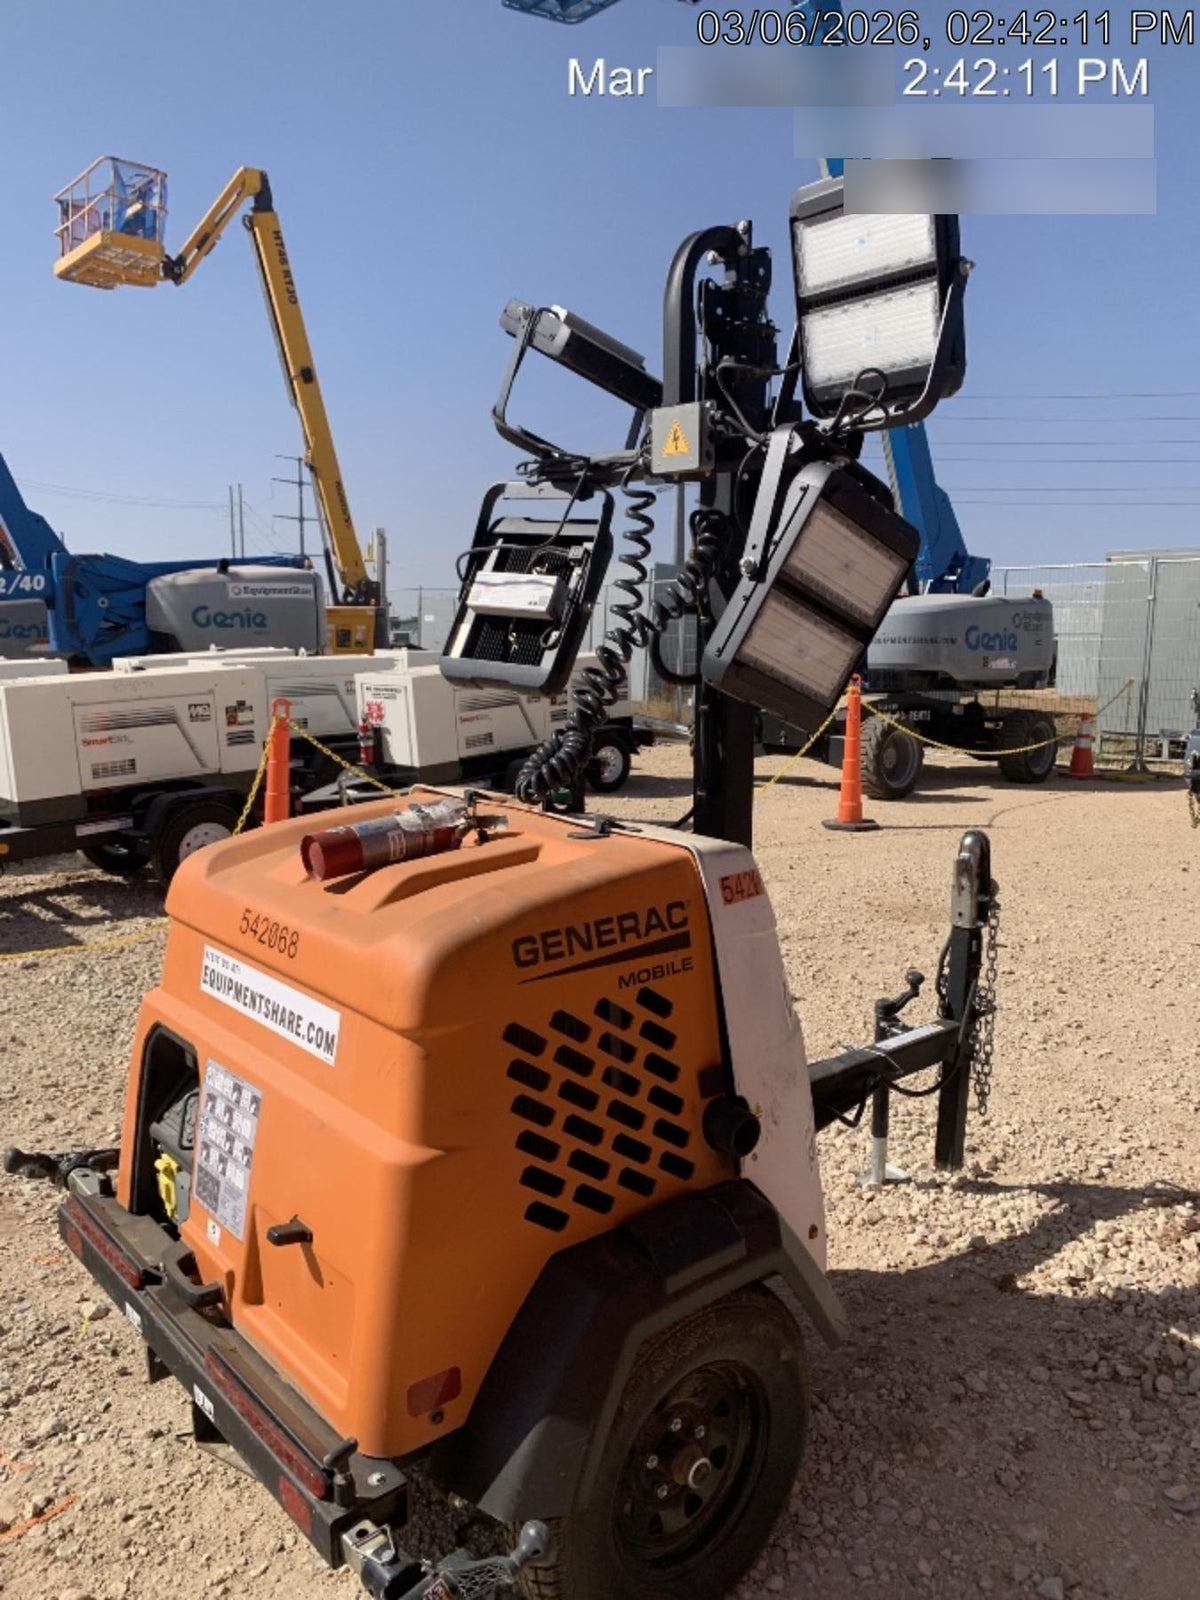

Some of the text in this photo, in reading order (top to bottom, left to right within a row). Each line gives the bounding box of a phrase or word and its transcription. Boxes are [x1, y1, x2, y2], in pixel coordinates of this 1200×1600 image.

[191, 605, 268, 629] Genie
[965, 625, 1018, 651] Genie
[239, 908, 300, 959] 542068
[511, 900, 689, 968] GENERAC
[617, 956, 694, 989] MOBILE
[202, 965, 336, 1056] EQUIPMENTSHARE.COM
